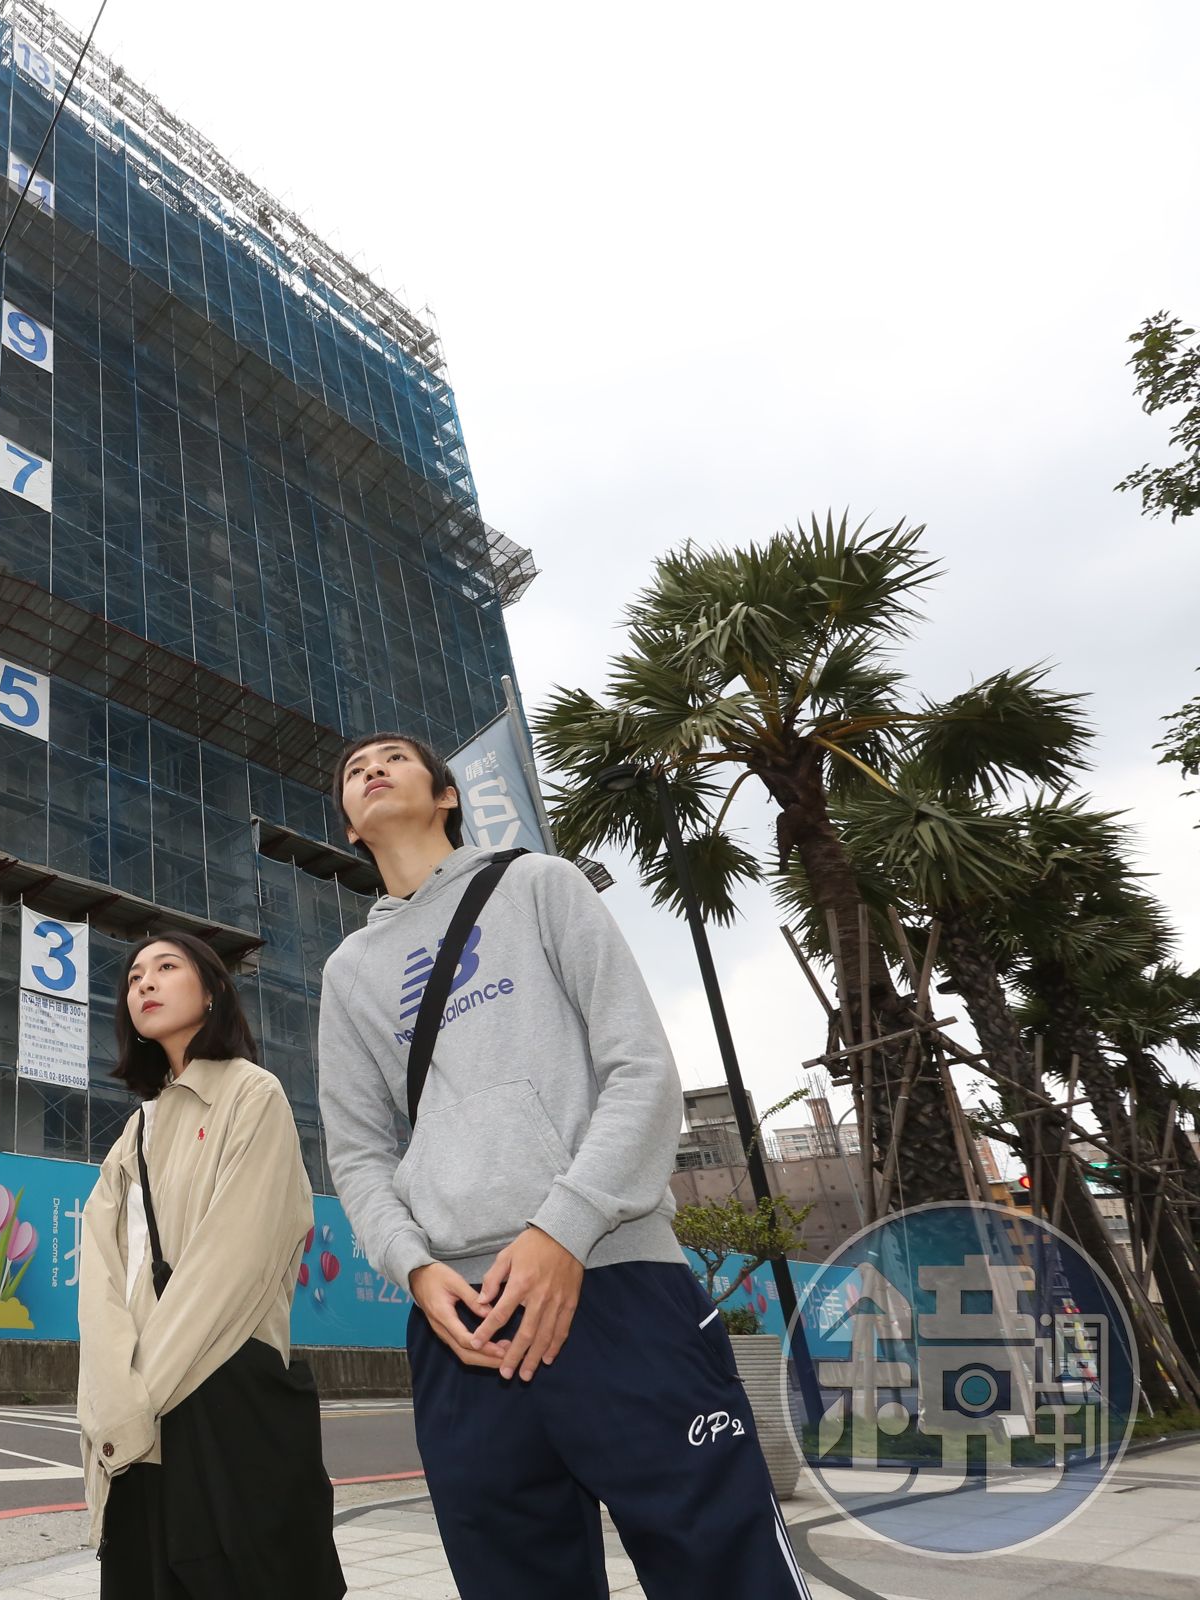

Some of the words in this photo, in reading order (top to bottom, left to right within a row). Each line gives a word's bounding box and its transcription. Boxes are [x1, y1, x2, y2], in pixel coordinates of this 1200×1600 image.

[18, 43, 51, 85] 13
[11, 163, 50, 213] 11
[7, 311, 48, 362] 9
[7, 443, 43, 494] 7
[465, 750, 499, 781] 晴空
[31, 920, 77, 991] 3
[394, 1027, 415, 1045] ne
[377, 1272, 410, 1303] 22
